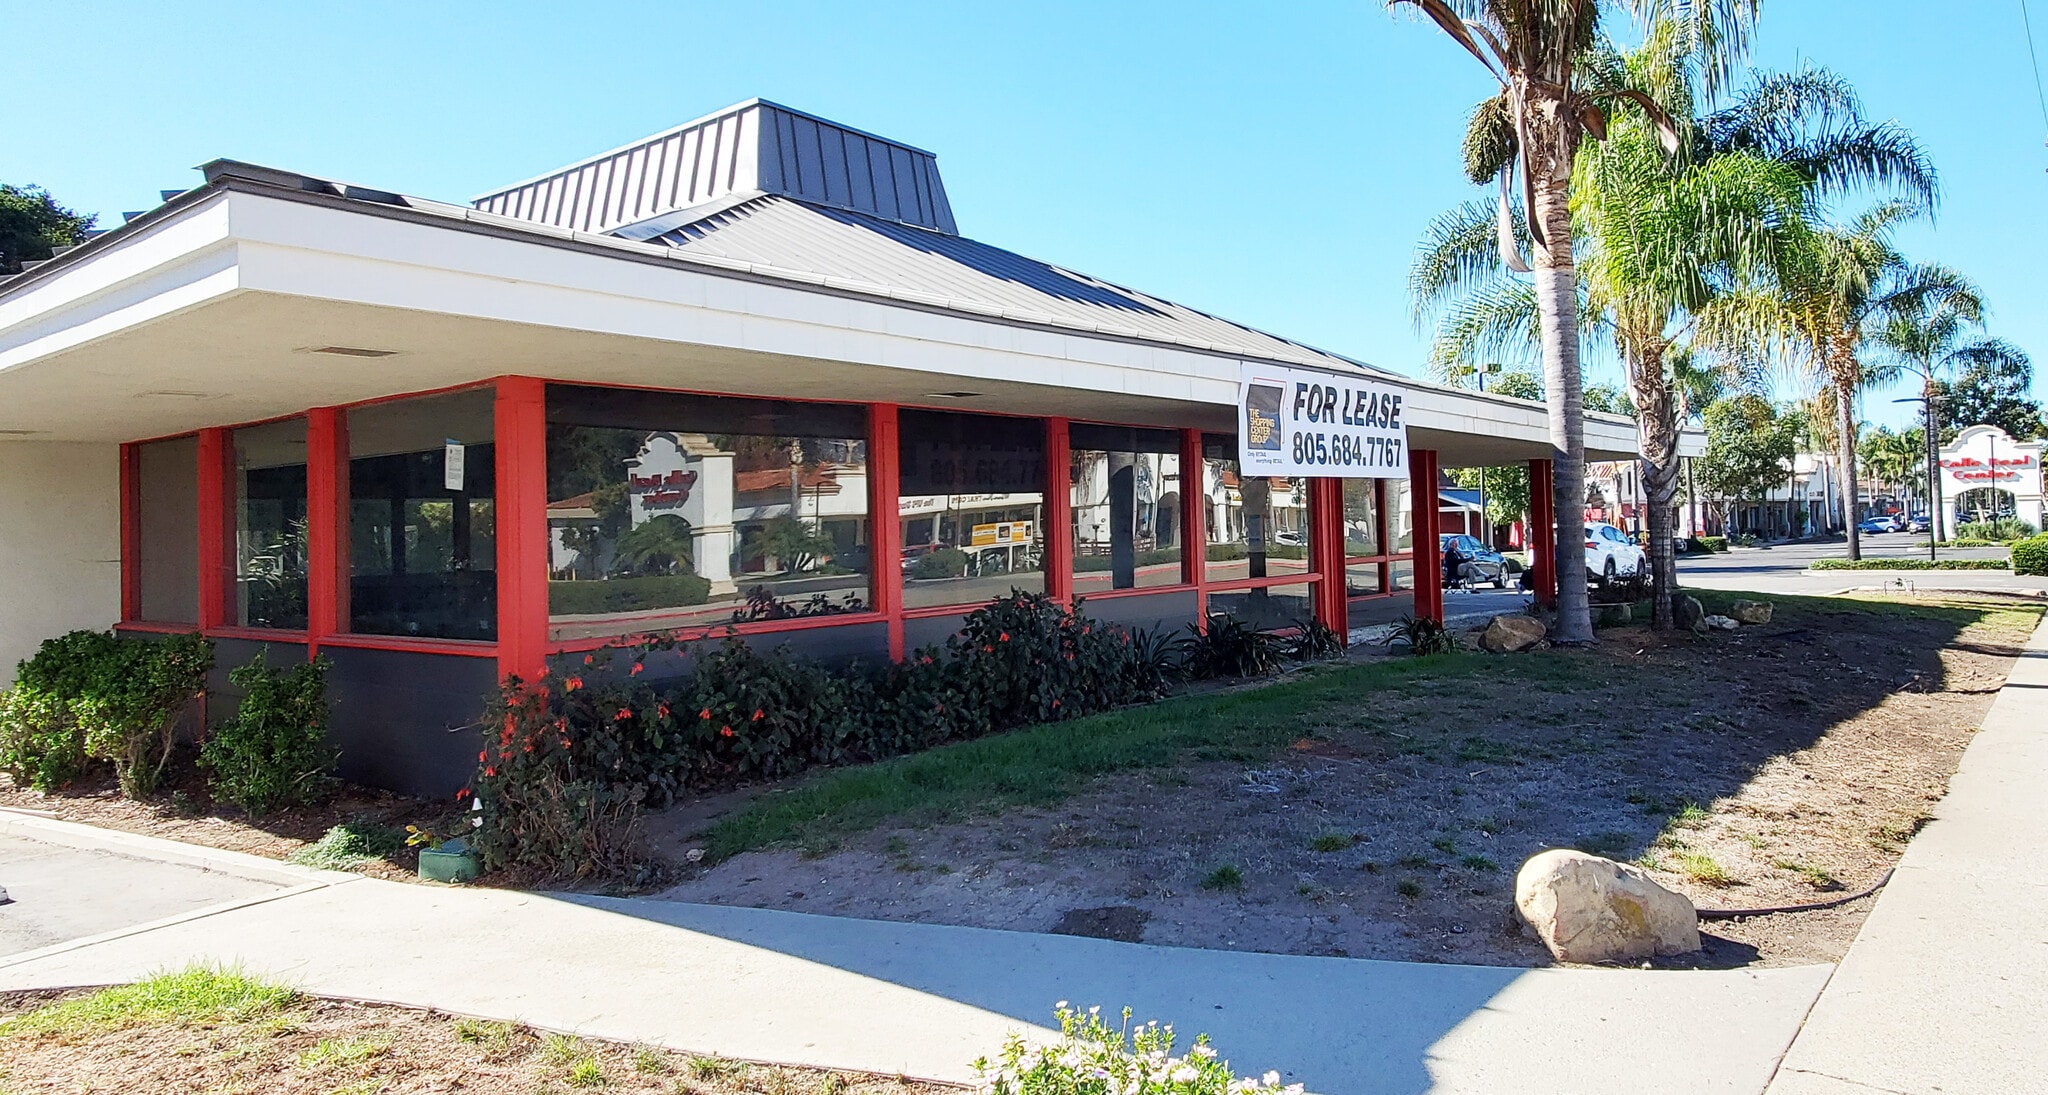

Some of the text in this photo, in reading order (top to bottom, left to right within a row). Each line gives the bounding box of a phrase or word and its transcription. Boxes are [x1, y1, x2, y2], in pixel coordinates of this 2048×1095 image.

[1293, 382, 1402, 430] FOR LEASE
[1249, 408, 1260, 418] THE
[1250, 417, 1275, 428] SHOPPING
[1251, 426, 1271, 436] CENTER
[1251, 434, 1267, 444] GROUP
[1293, 431, 1402, 468] 805.684.7767
[1938, 457, 1981, 468] Calle
[1953, 470, 2016, 480] Center
